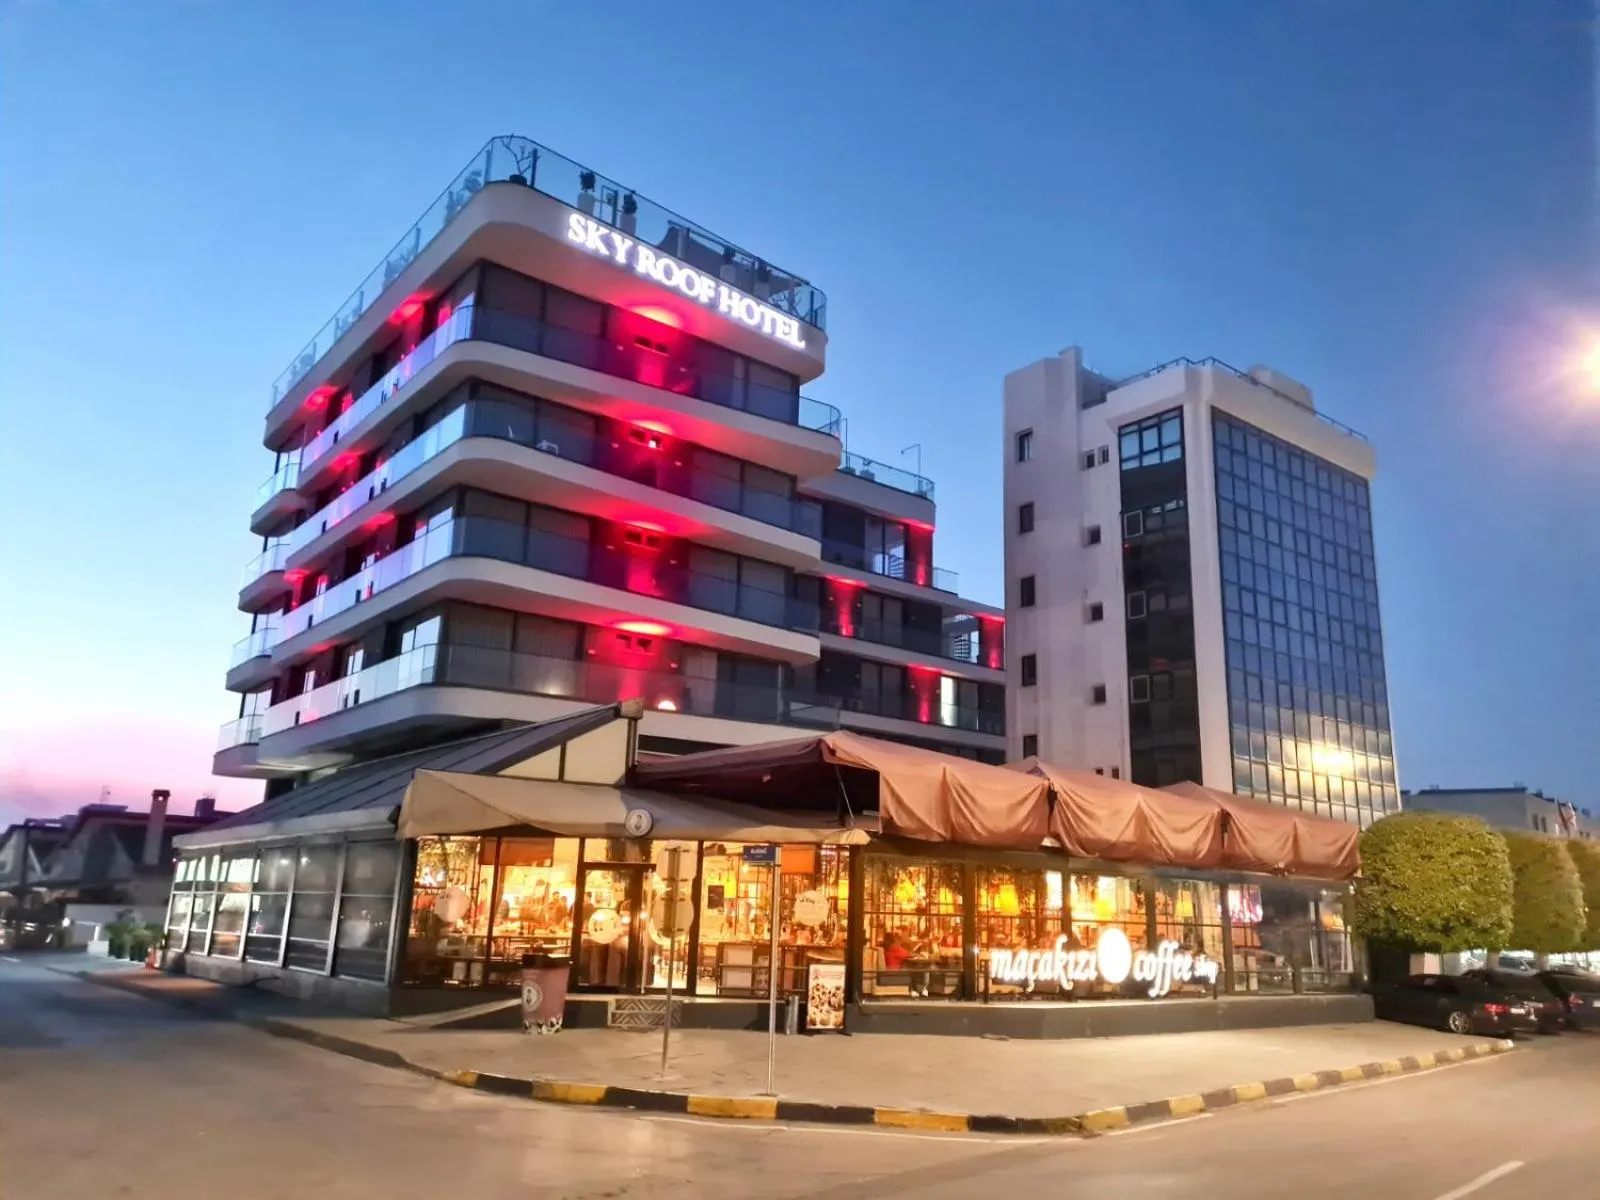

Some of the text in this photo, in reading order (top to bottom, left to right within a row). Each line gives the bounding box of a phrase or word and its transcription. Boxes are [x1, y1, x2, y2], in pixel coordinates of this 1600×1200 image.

[567, 213, 806, 349] SKY ROOF HOTEL
[1133, 940, 1193, 997] coffee
